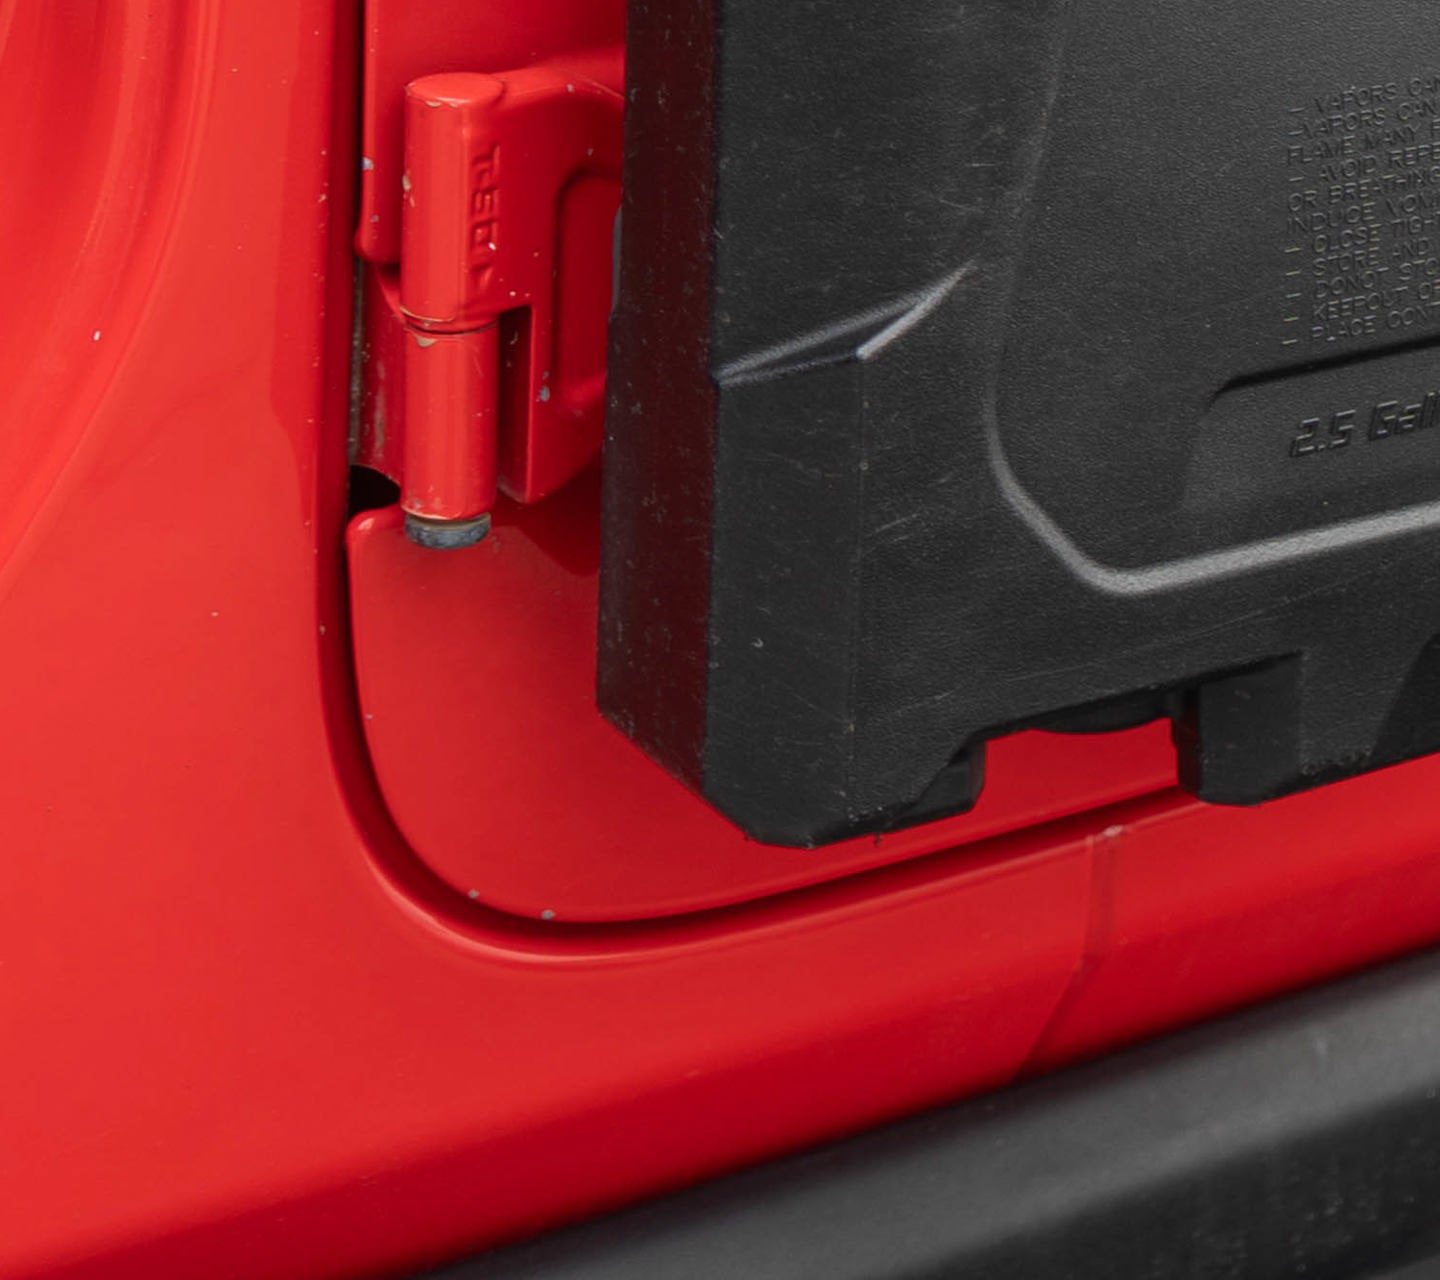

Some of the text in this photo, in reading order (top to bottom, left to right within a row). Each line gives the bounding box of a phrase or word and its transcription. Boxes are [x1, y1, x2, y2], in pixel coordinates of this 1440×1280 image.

[1318, 154, 1377, 184] AVOID
[1288, 189, 1317, 213] OR
[1285, 201, 1375, 237] INDUCE
[1314, 222, 1381, 253] CLOSE
[1312, 245, 1378, 277] STORE
[1390, 235, 1427, 261] AND
[1310, 312, 1376, 344] PLACE
[1289, 409, 1357, 458] 2.5
